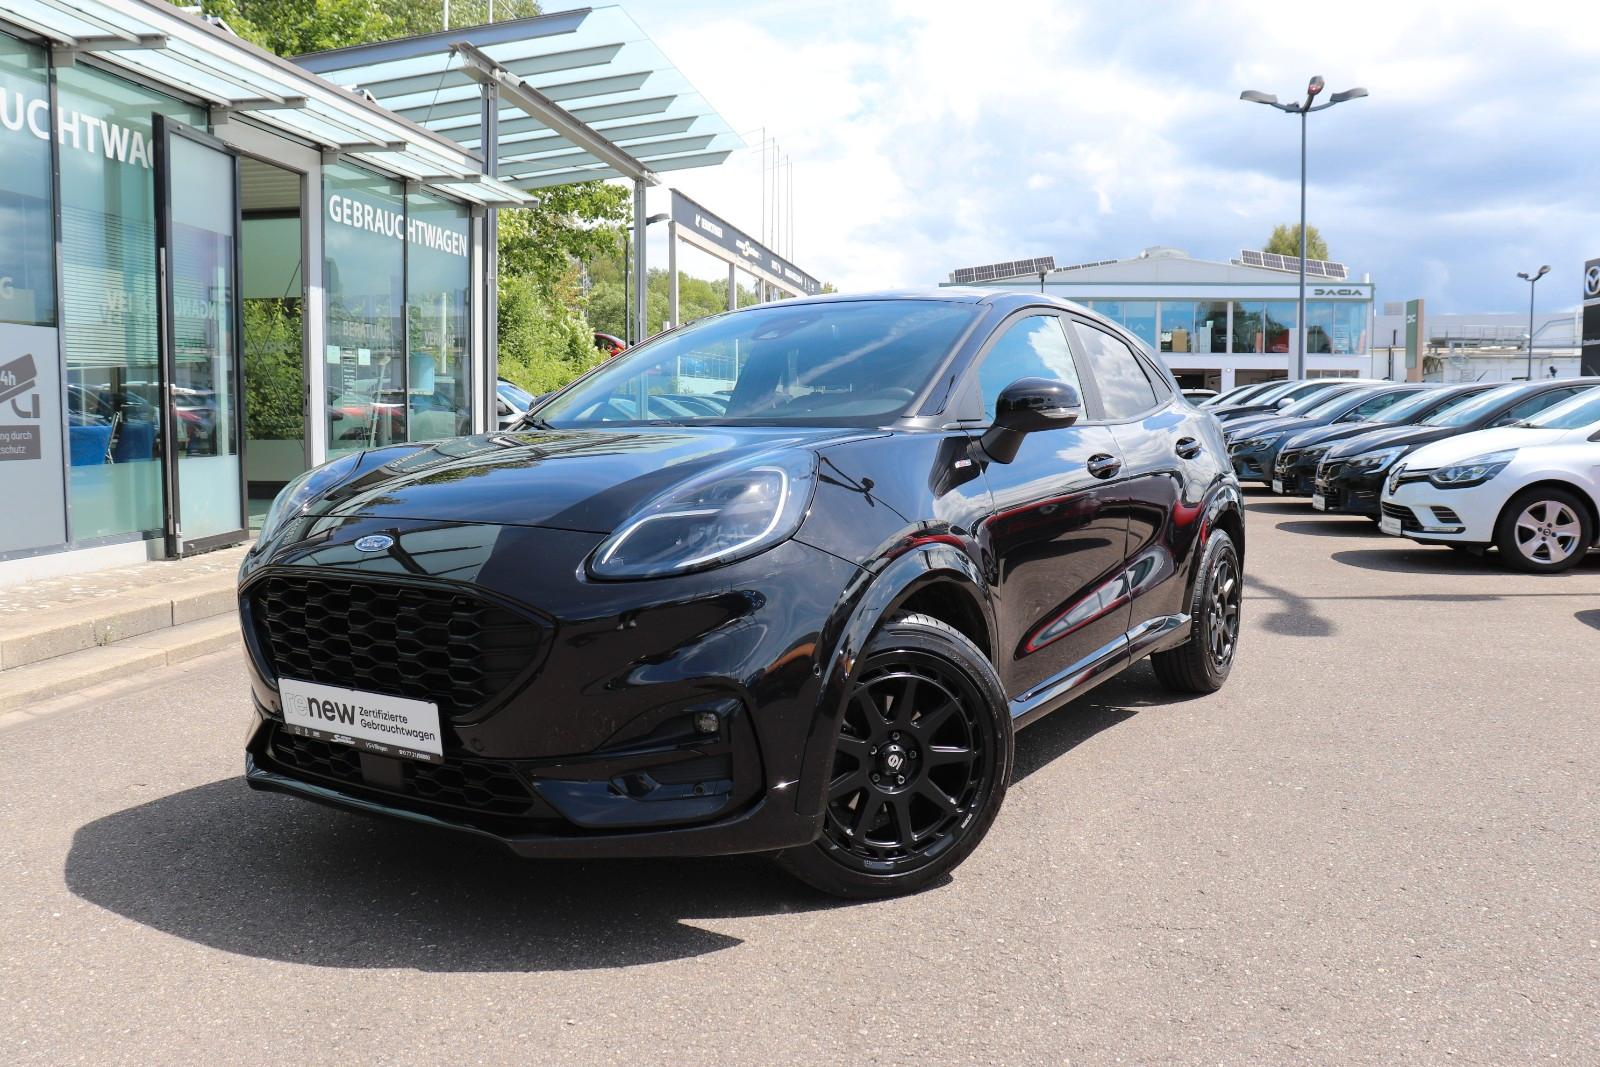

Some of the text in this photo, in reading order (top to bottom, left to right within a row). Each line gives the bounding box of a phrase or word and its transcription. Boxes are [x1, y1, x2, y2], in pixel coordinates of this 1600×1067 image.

[0, 86, 154, 169] UCHTWA
[329, 194, 467, 257] GEBRAUCHTWAGEN
[1313, 288, 1362, 296] DACIA
[11, 431, 33, 440] durch
[358, 706, 408, 724] Zertifizierte
[360, 718, 435, 741] Gebrauchtwagen
